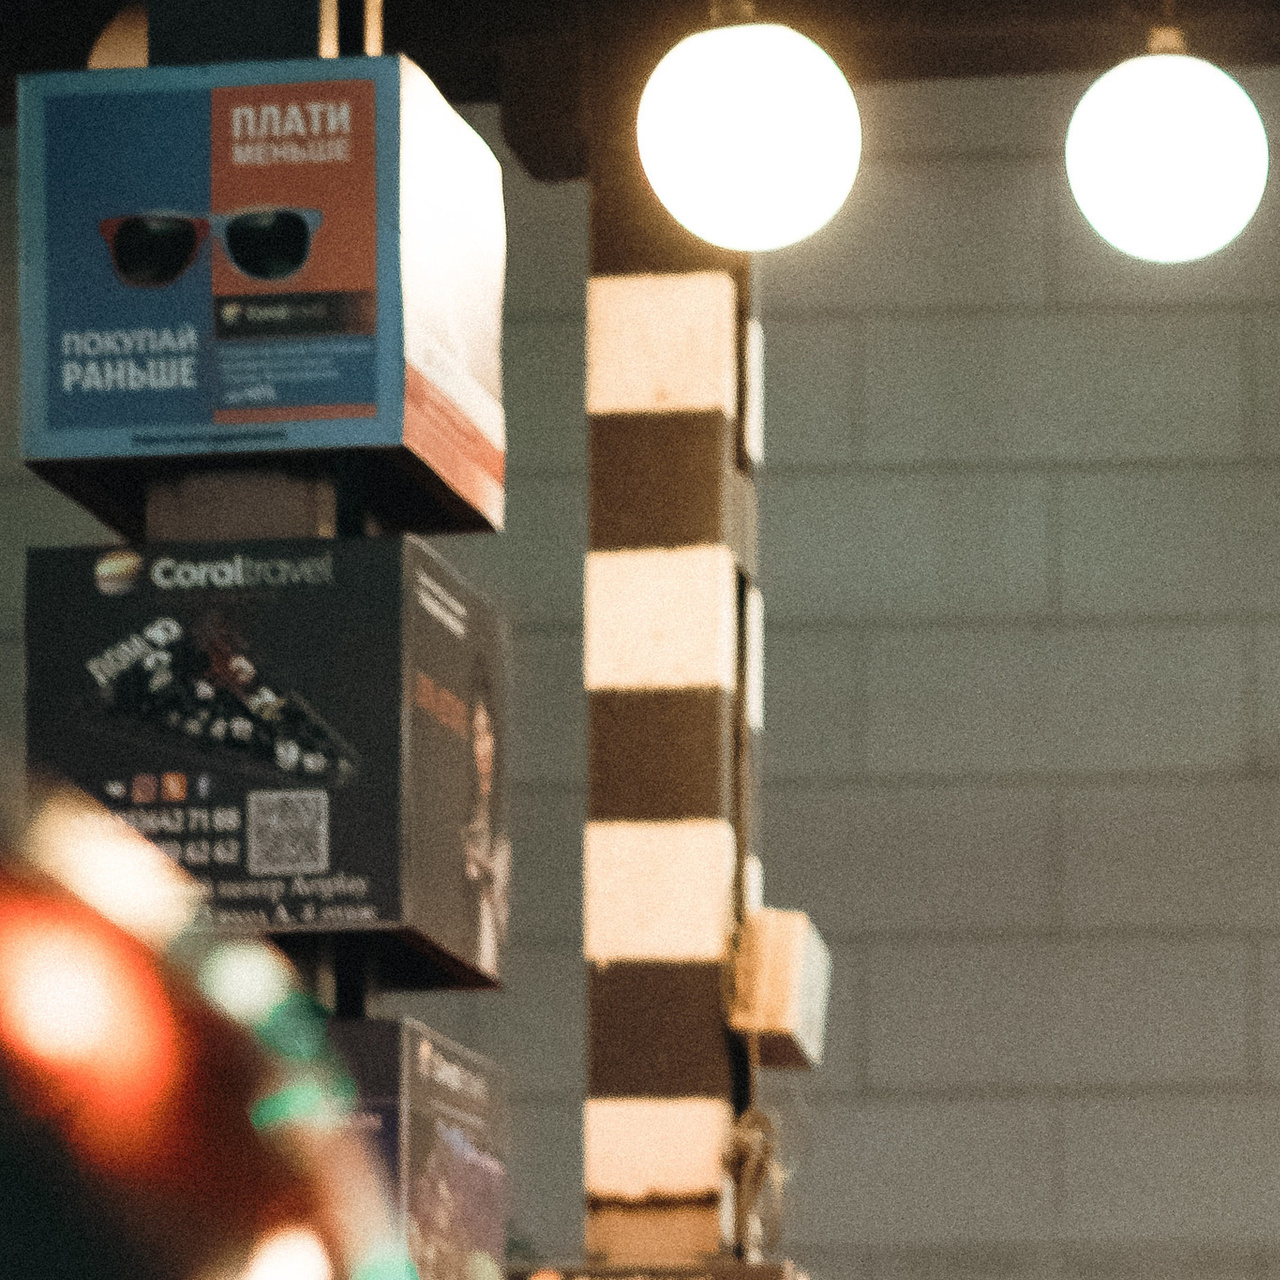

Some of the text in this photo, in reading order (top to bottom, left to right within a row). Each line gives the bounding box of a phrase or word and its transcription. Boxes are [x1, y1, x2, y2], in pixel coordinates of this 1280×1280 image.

[231, 101, 352, 138] ПЛАТИ
[231, 138, 351, 166] МЕНЬШЕ
[62, 325, 198, 358] ПОКУПАЙ
[62, 357, 197, 392] РАНЬШЕ
